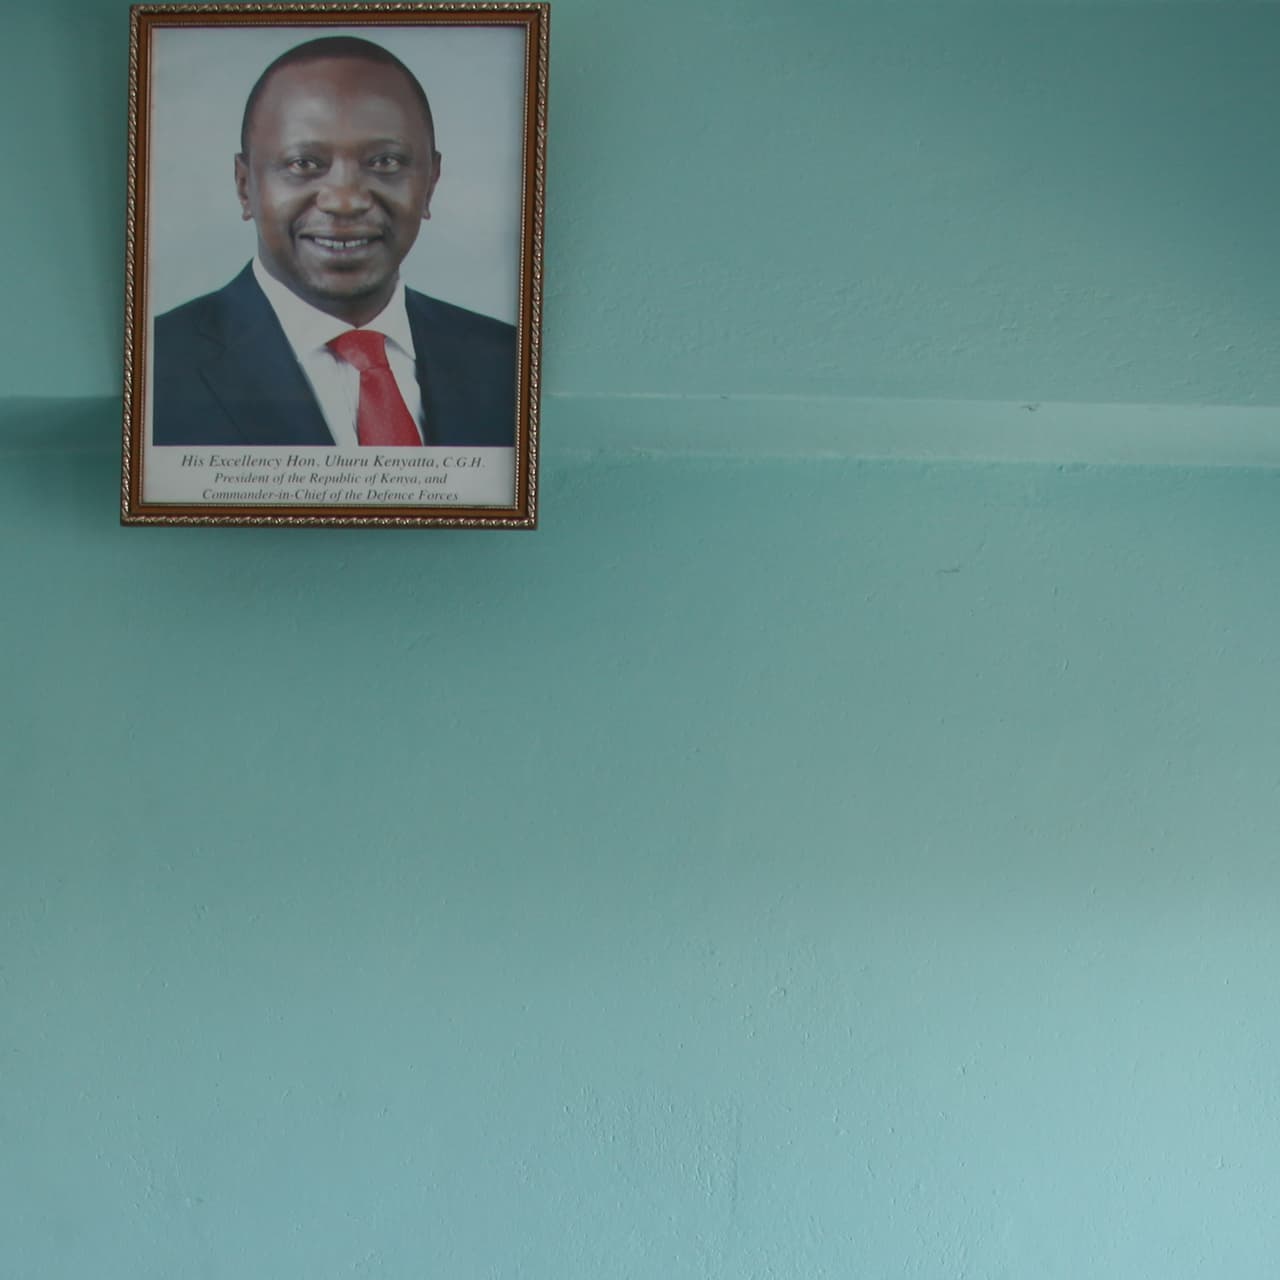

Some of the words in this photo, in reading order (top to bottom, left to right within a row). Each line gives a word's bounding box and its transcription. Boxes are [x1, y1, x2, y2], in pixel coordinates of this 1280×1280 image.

[181, 454, 205, 467] His
[209, 453, 282, 470] Excellency
[286, 454, 320, 467] Hon.
[325, 454, 368, 468] Uhuru
[214, 472, 270, 484] President
[272, 472, 285, 485] of
[287, 472, 306, 484] the
[309, 472, 362, 486] Republic
[364, 472, 377, 486] of
[424, 473, 448, 484] and
[202, 488, 327, 501] Commander-in-Chief
[329, 489, 342, 502] of
[344, 489, 363, 501] the
[367, 489, 415, 502] Defence
[418, 489, 459, 501] Forces
